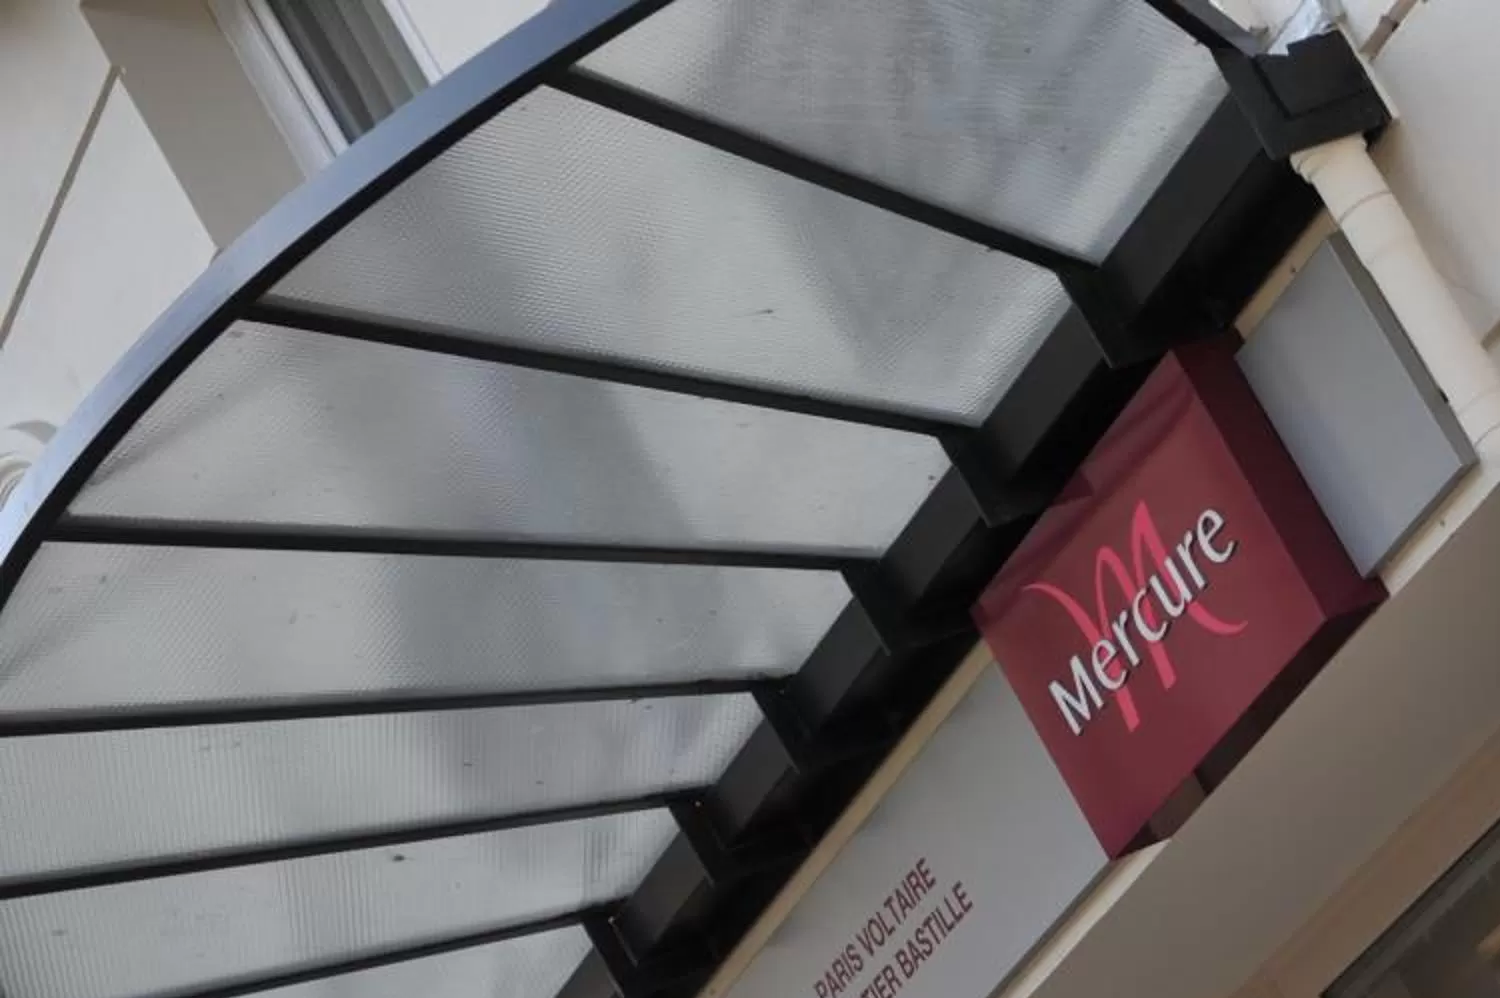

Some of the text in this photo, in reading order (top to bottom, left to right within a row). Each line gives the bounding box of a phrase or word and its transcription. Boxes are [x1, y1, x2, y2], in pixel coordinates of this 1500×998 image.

[1049, 508, 1237, 736] Mercure
[856, 857, 936, 956] VOLTAIRE
[895, 880, 973, 980] BASTILLE
